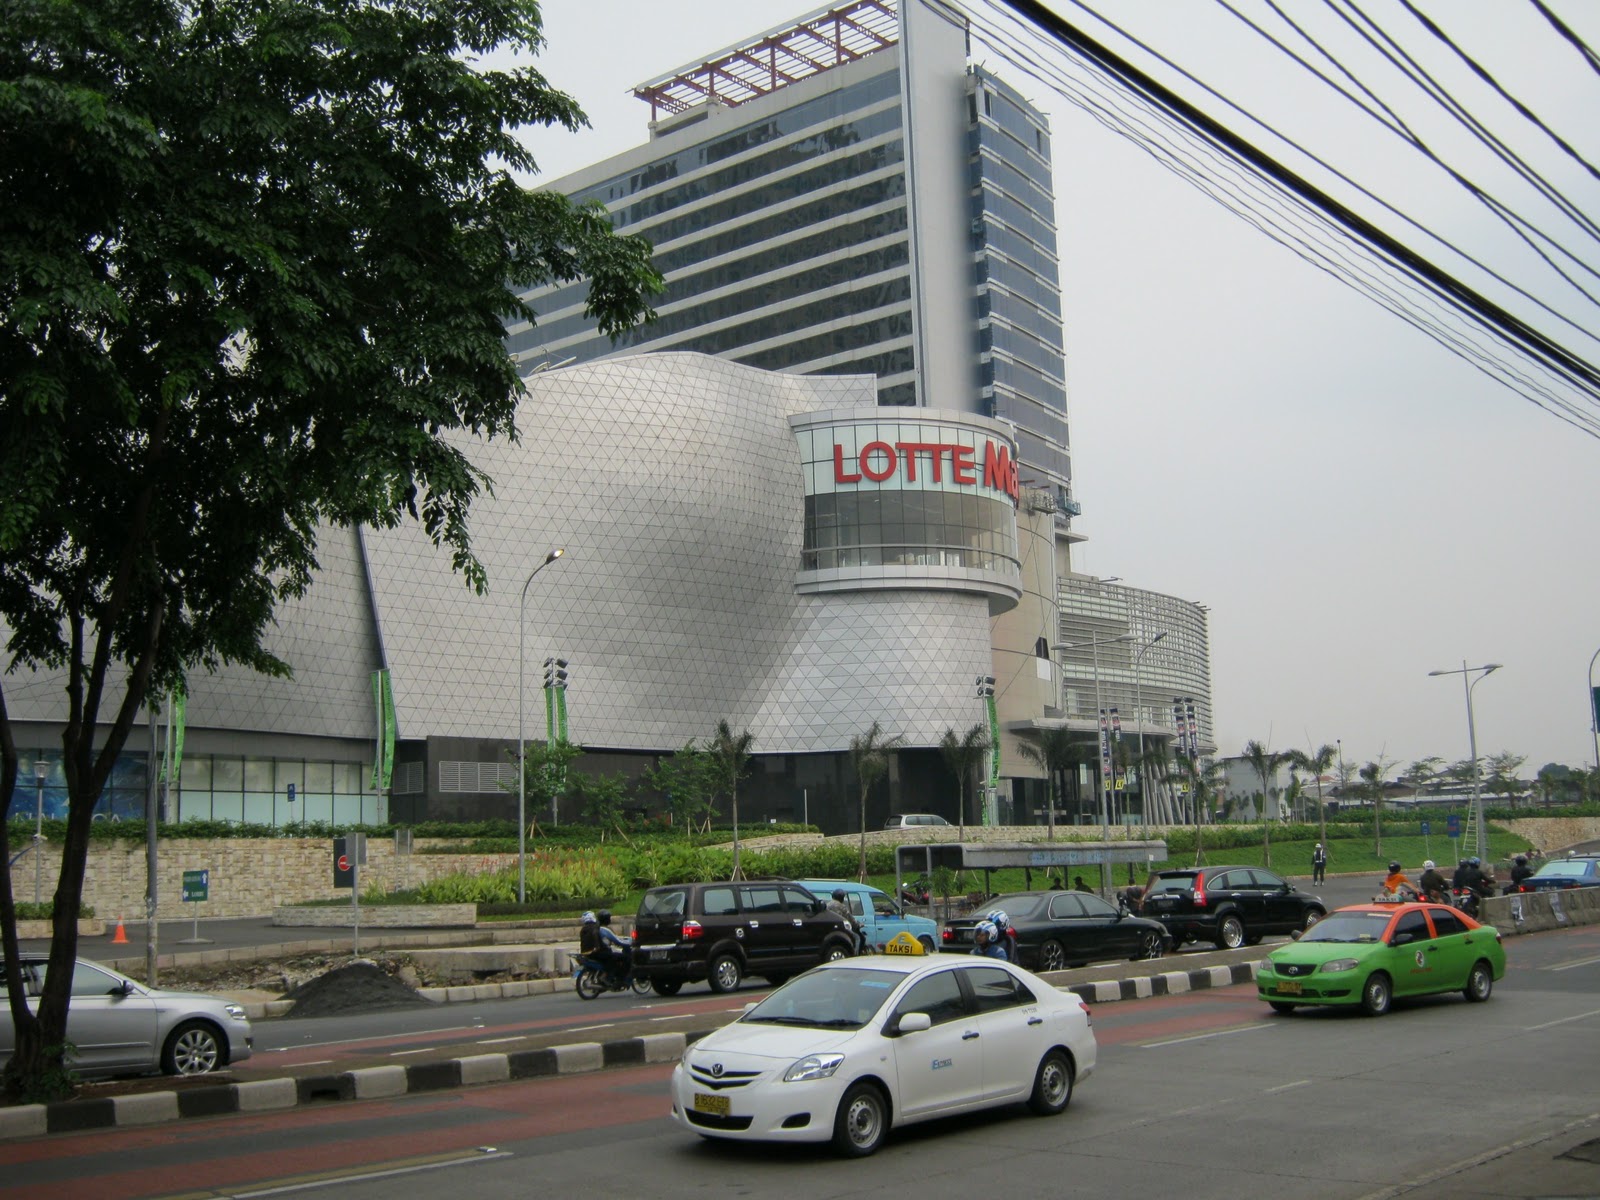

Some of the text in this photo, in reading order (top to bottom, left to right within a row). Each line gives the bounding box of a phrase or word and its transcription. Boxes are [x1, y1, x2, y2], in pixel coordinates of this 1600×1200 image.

[833, 440, 1019, 503] LOTTE Ma
[889, 944, 913, 954] TAKSI
[694, 1093, 699, 1105] B
